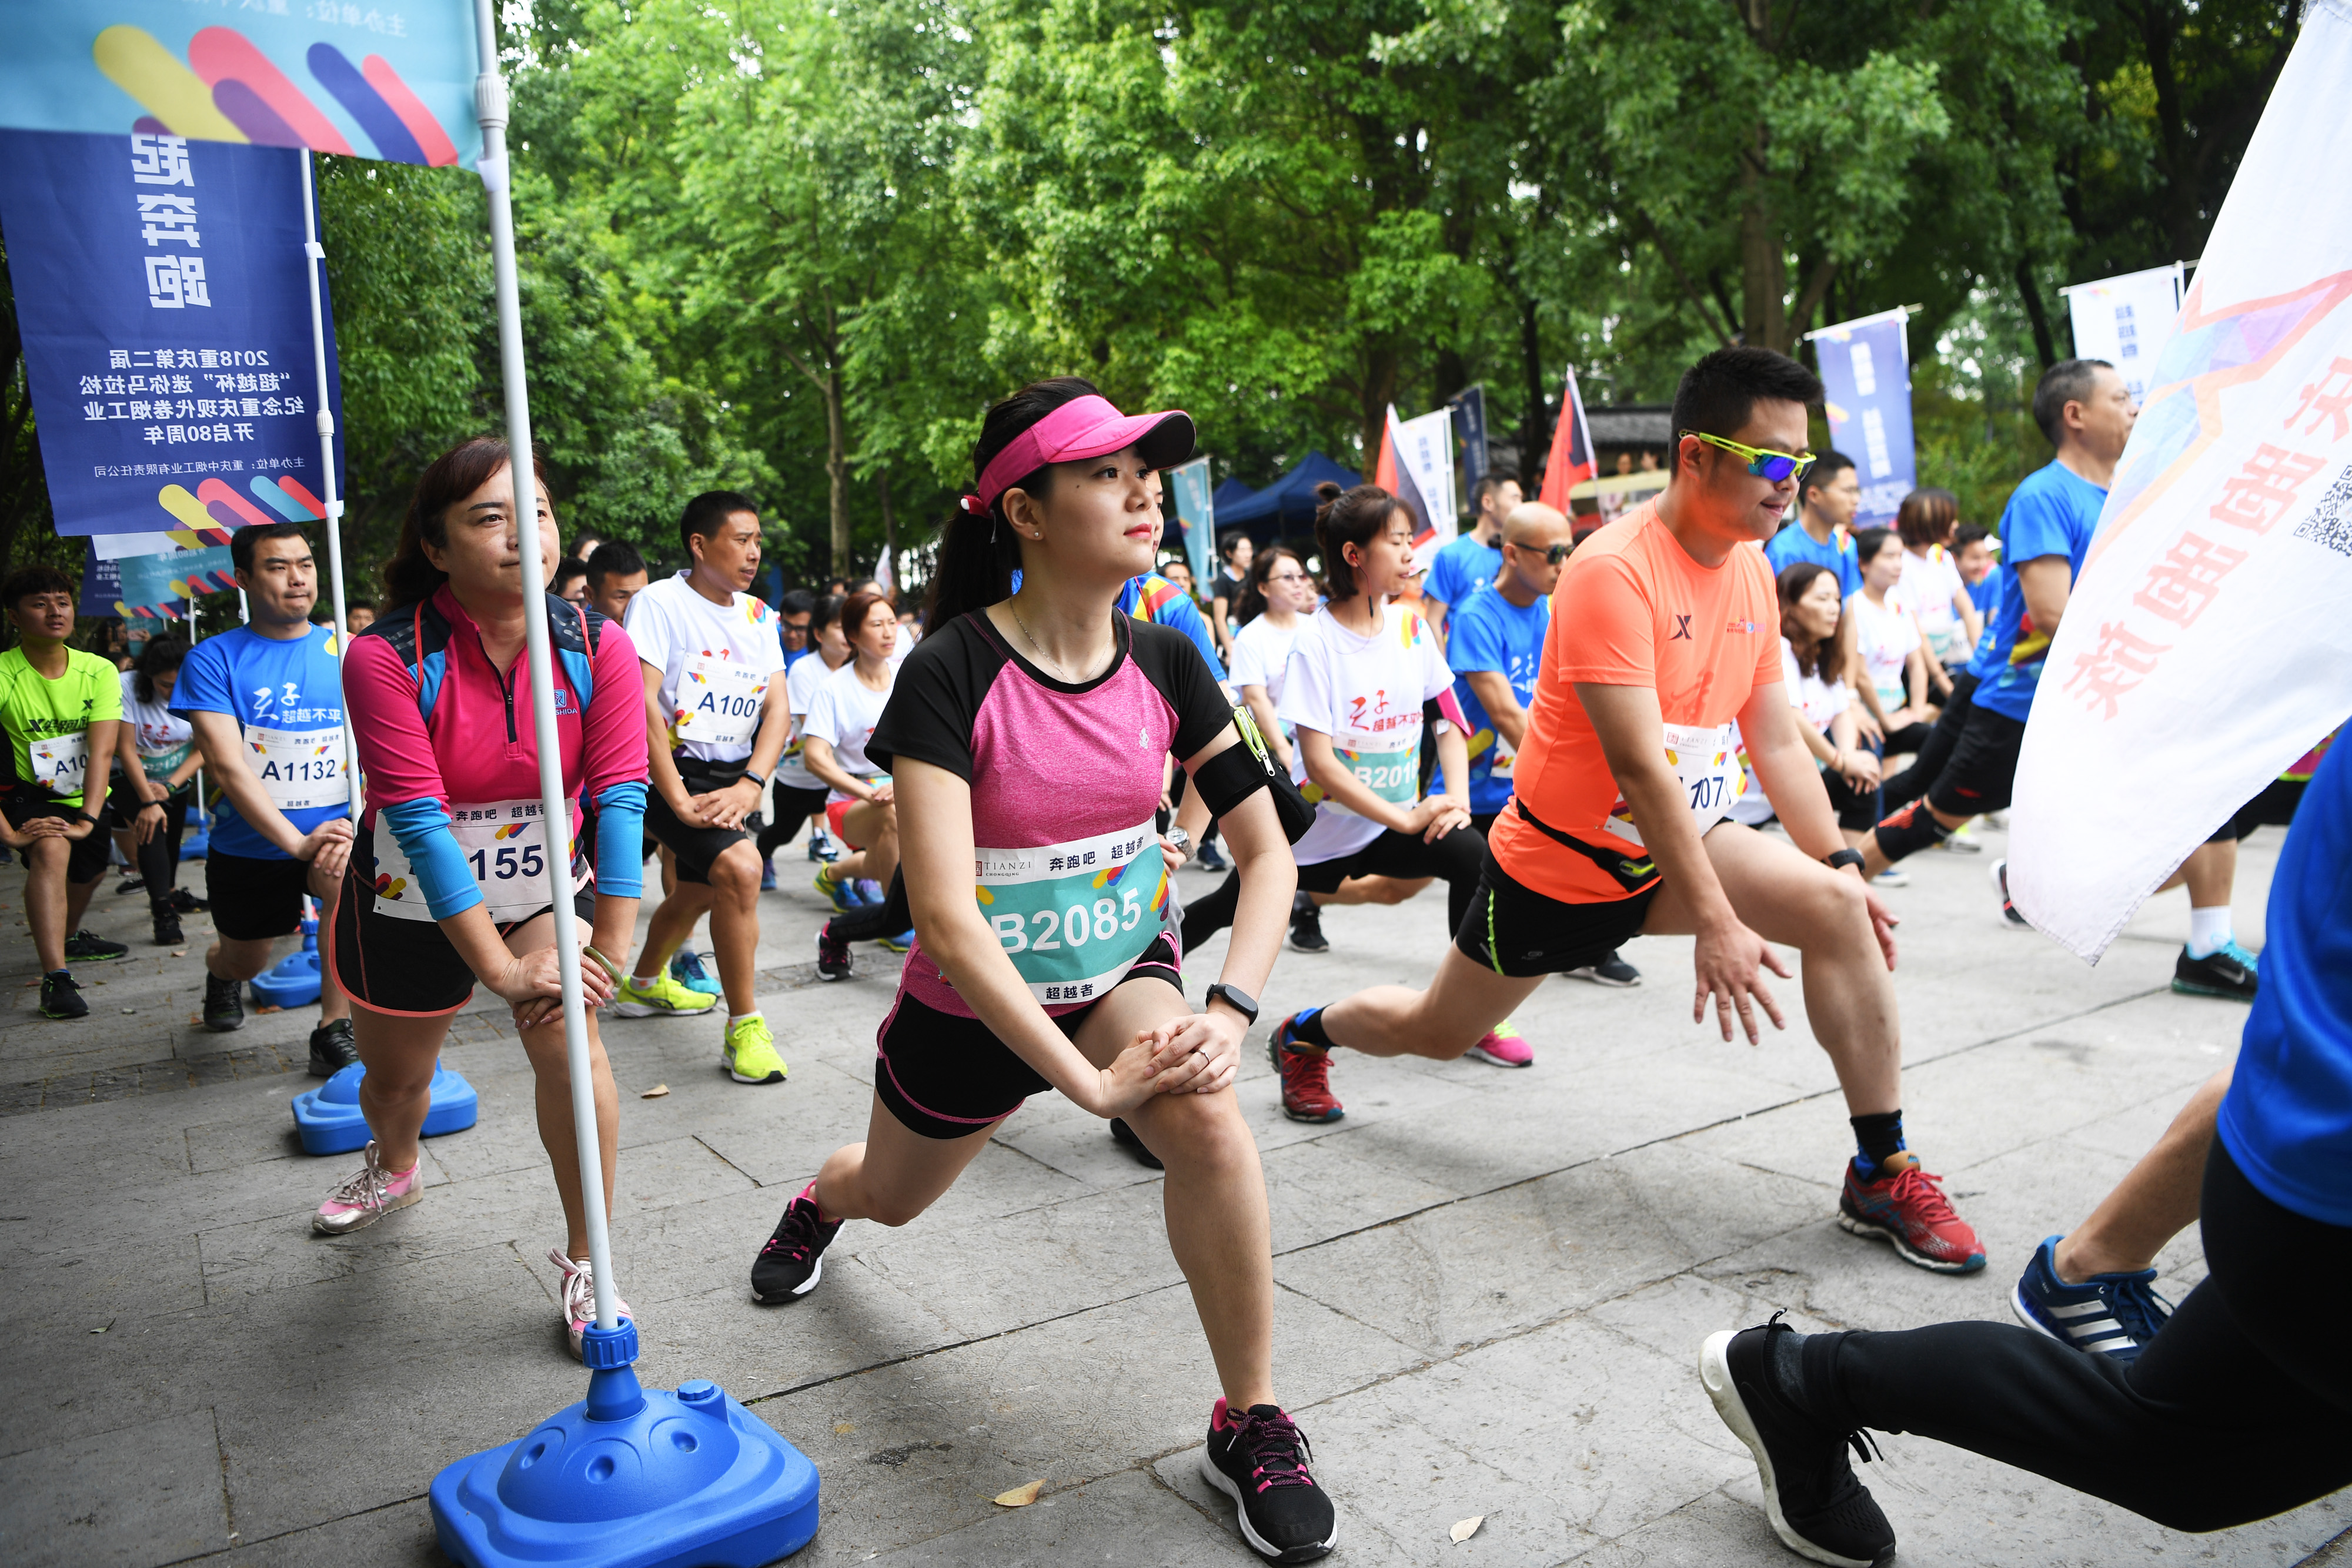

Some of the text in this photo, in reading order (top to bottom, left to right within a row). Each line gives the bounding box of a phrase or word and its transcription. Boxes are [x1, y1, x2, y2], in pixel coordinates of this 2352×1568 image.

[697, 691, 764, 717] A100
[261, 759, 336, 781] A1132
[456, 808, 497, 821] 奔跑吧
[1050, 835, 1144, 871] 奔跑吧 超越者
[984, 861, 1031, 870] TIANZI
[991, 888, 1141, 954] B2085
[1046, 984, 1094, 999] 超越者
